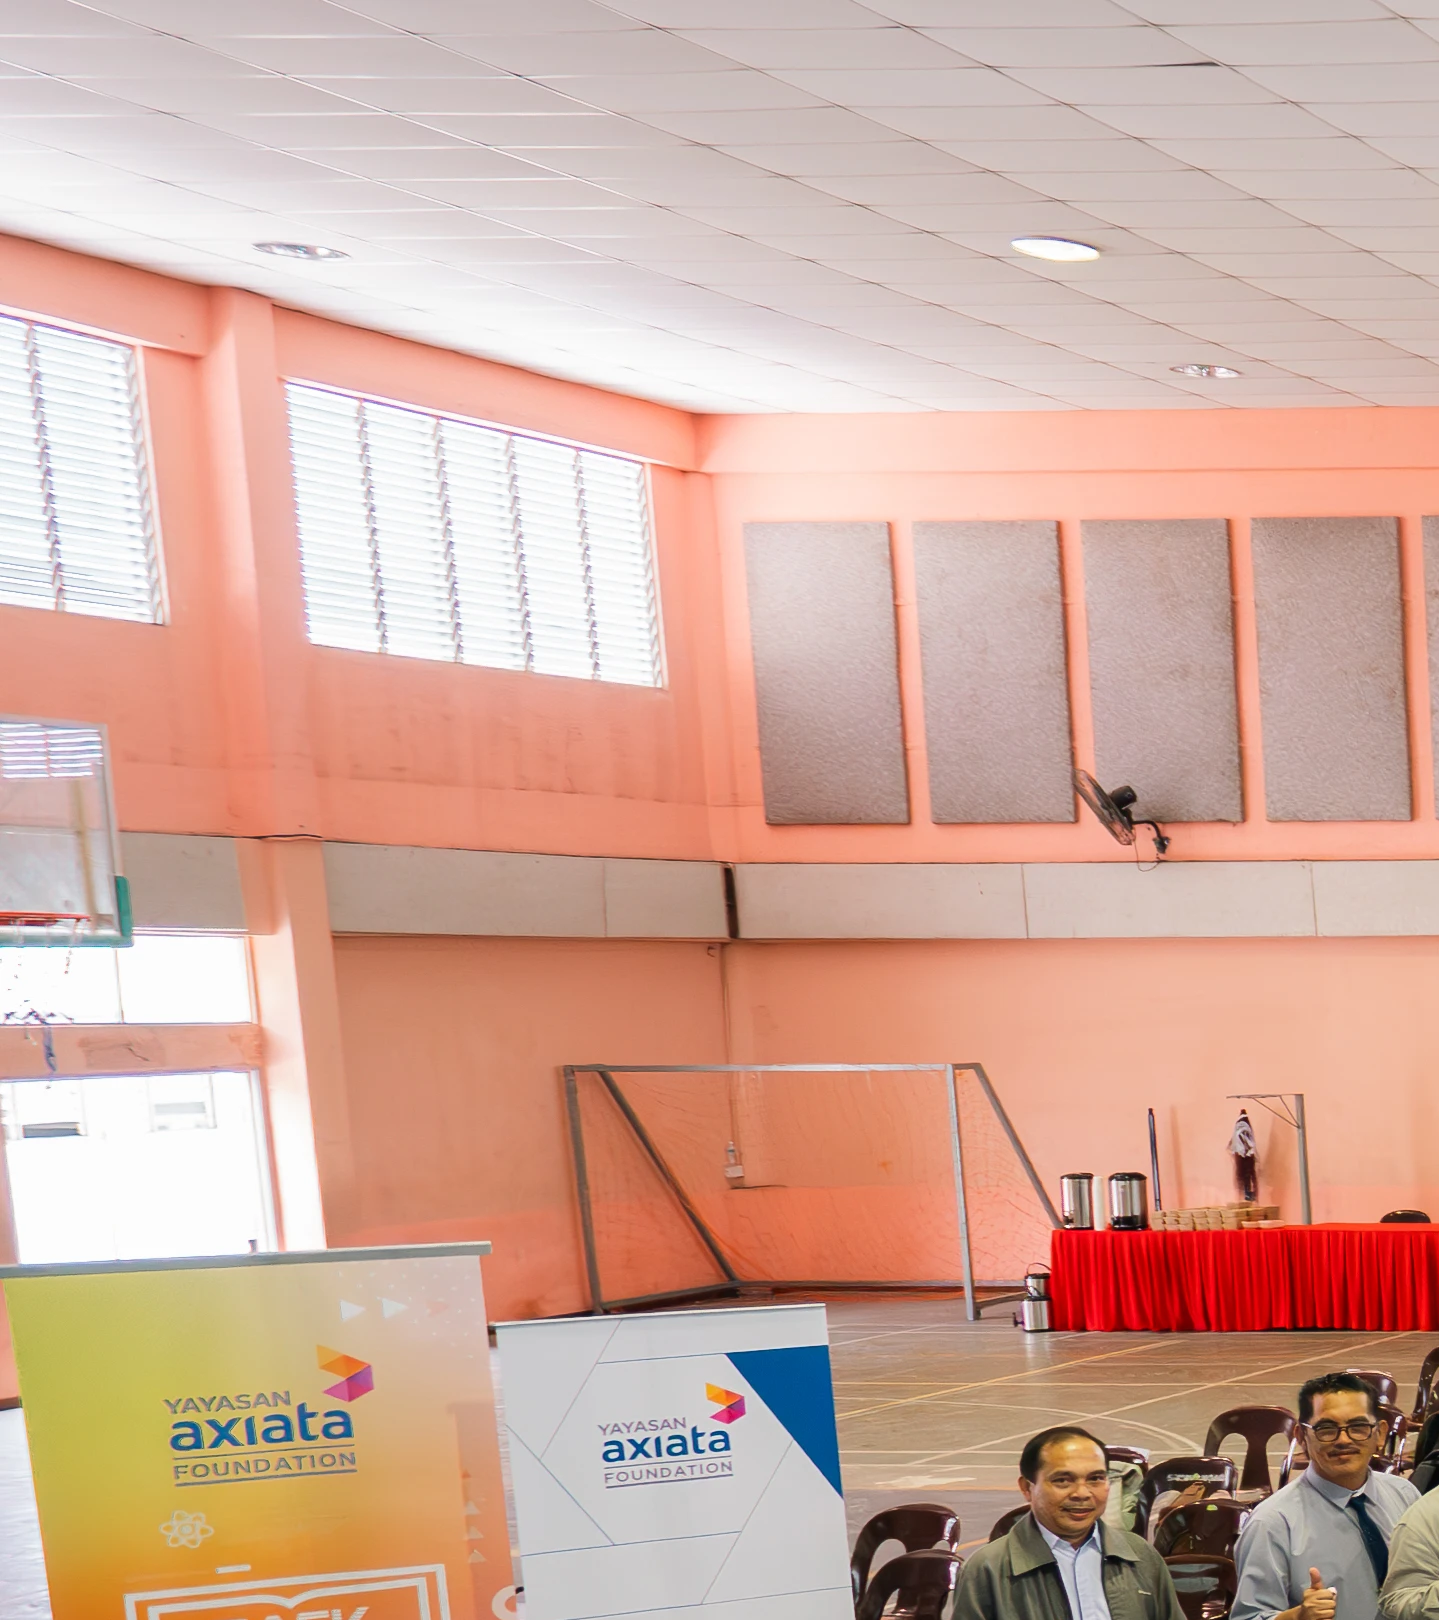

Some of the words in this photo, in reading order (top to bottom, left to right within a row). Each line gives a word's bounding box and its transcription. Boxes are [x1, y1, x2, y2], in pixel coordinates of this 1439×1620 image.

[162, 1390, 292, 1414] YAYASAN
[169, 1402, 354, 1451] axiata
[597, 1417, 687, 1436] YAYASAN
[602, 1425, 732, 1462] axiata
[173, 1452, 356, 1479] FOUNDATION
[604, 1461, 733, 1484] FOUNDATION
